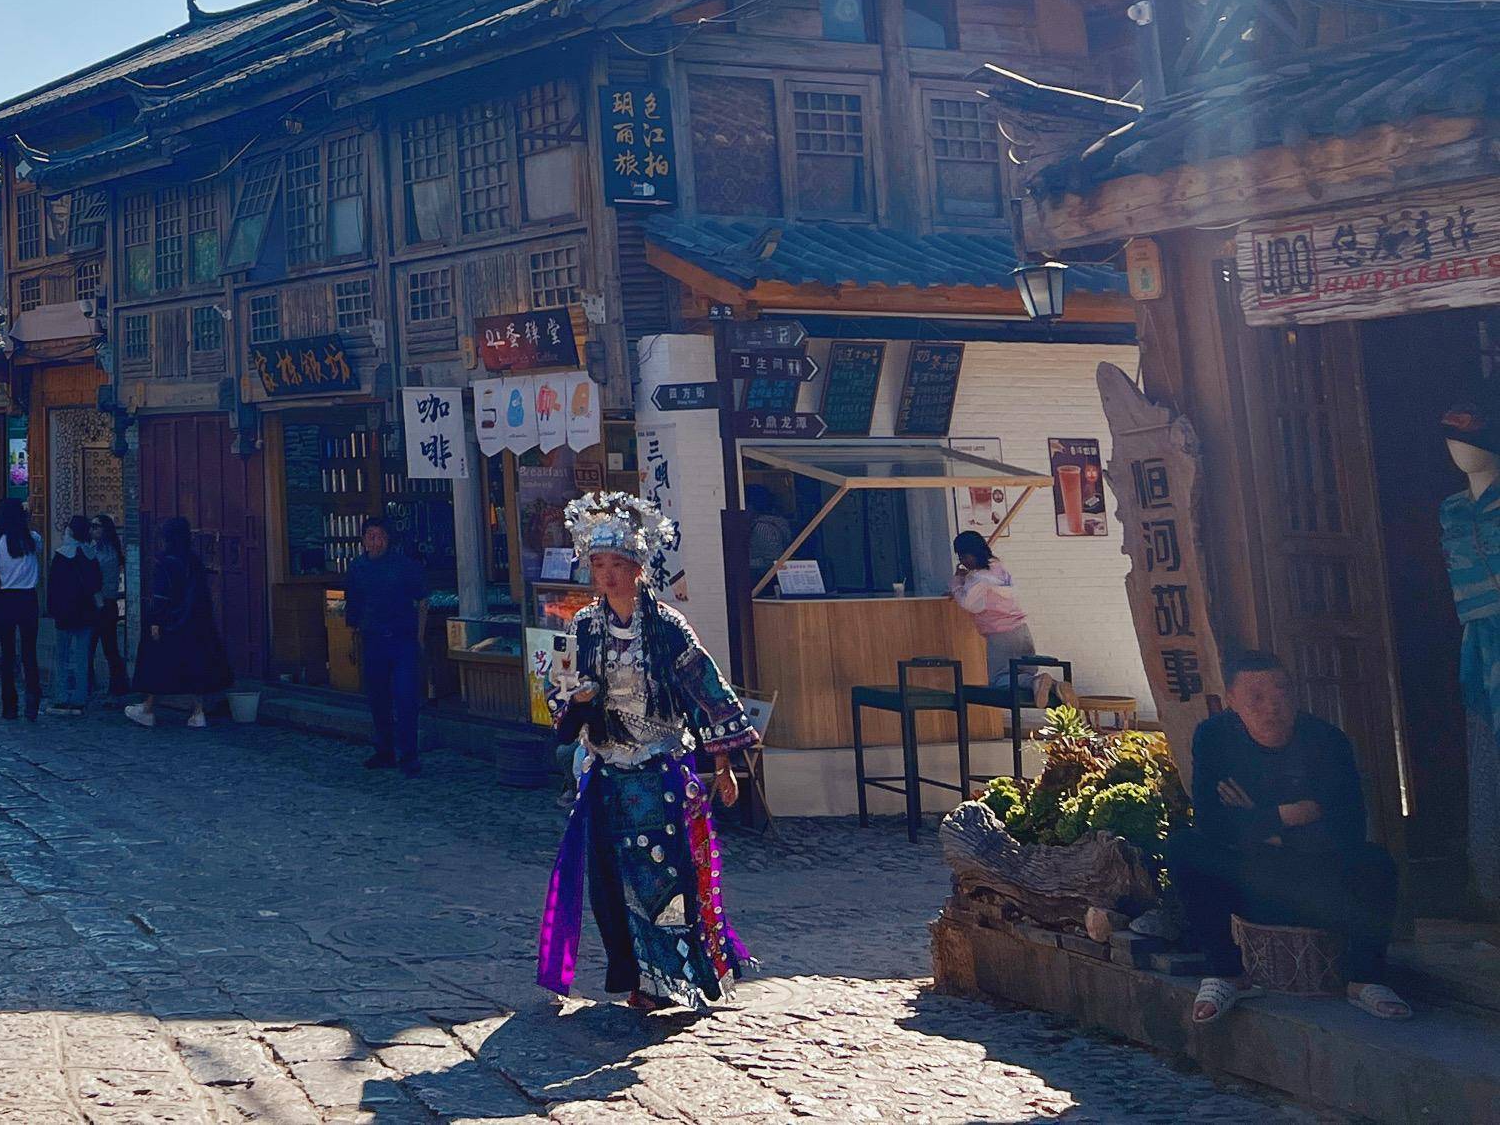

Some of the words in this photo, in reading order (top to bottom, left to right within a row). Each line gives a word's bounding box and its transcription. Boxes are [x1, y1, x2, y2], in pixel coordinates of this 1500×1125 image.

[740, 356, 783, 371] 卫生间
[668, 386, 706, 400] 四方街
[745, 415, 803, 430] 九鼎龙潭
[416, 393, 453, 470] 咖啡
[519, 466, 569, 477] Breakfast
